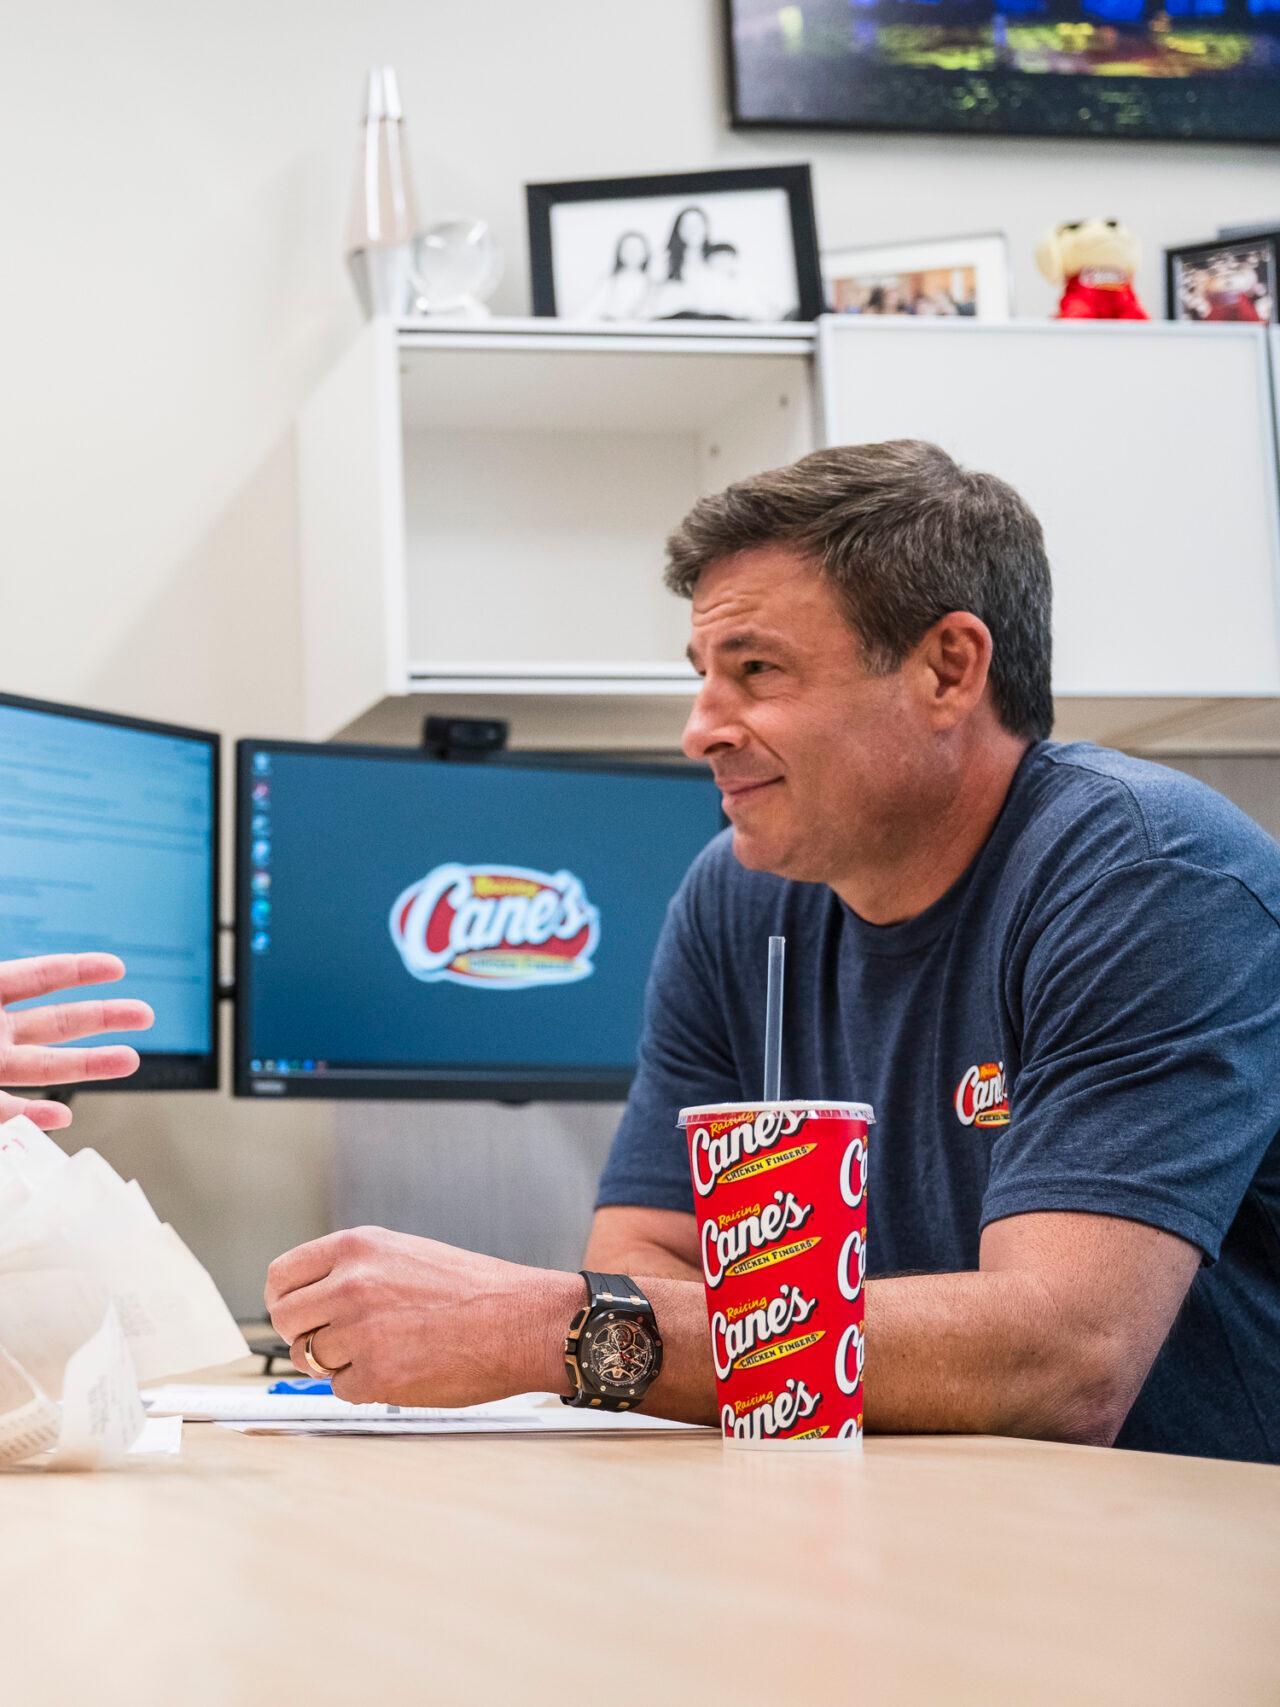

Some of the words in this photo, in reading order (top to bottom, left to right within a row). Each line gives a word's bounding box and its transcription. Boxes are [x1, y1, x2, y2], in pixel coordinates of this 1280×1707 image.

[402, 866, 595, 970] Cane's
[709, 1111, 756, 1137] Raising
[717, 1203, 761, 1229] Raising
[701, 1191, 811, 1288] Cane's
[726, 1296, 768, 1321] Raising
[711, 1284, 816, 1380] Cane's
[721, 1378, 821, 1440] Cane's
[734, 1390, 774, 1415] Raising
